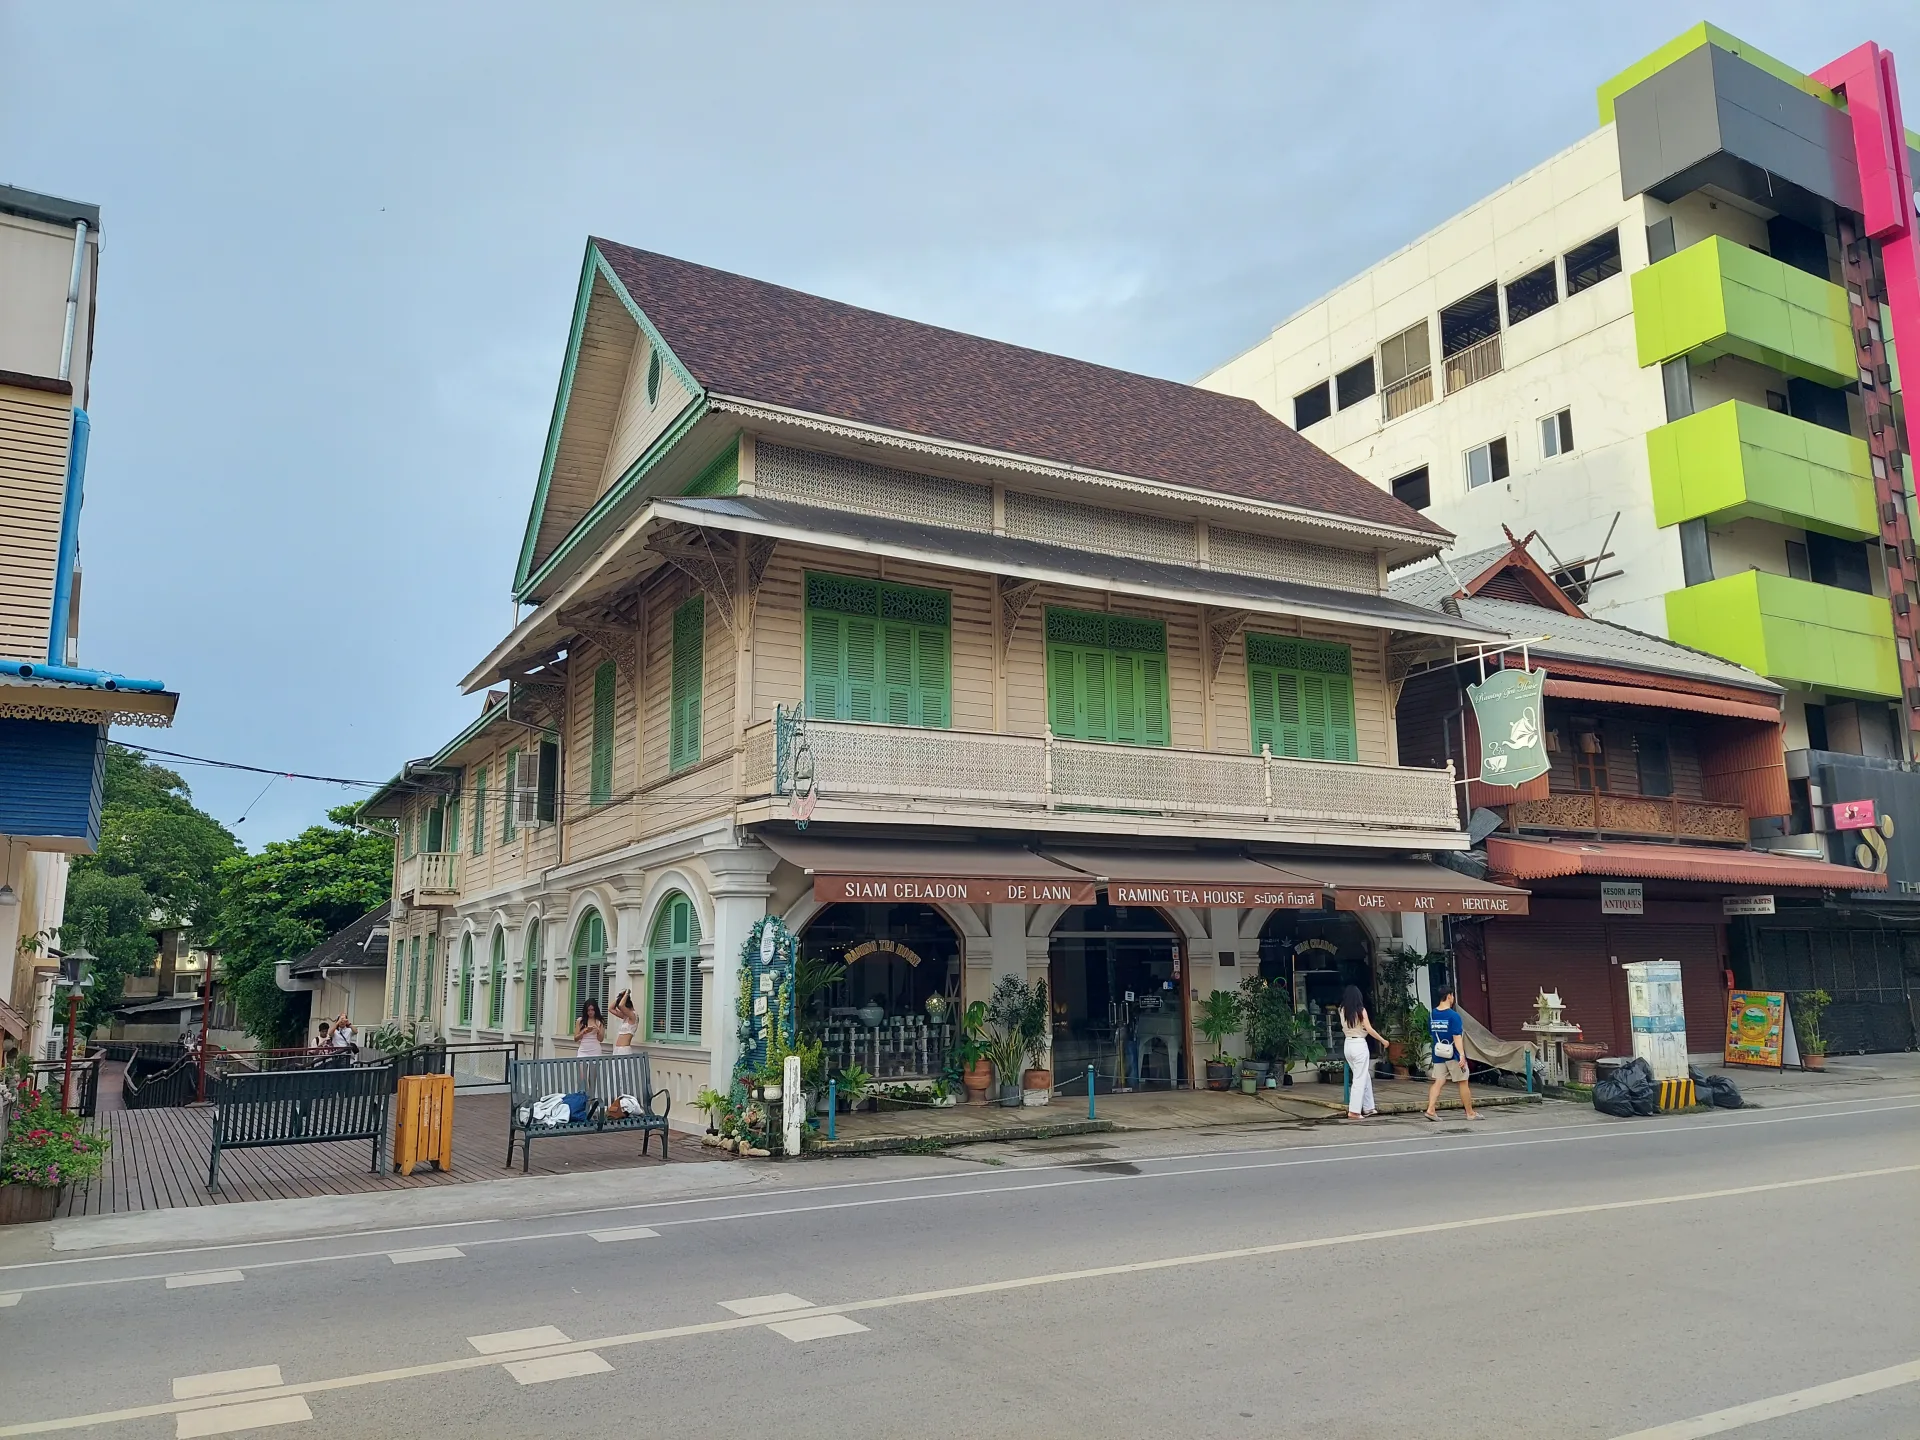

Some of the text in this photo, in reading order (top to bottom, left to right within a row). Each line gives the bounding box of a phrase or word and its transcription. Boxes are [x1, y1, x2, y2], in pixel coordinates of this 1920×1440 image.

[845, 883, 1071, 900] SIAM CELADON DE LANN
[1118, 888, 1245, 904] RAMING TEA HOUSE
[1603, 888, 1626, 896] KESORN
[1358, 895, 1509, 911] CAFE ART HERITAGE
[1604, 900, 1642, 910] ANTIQUES
[879, 940, 895, 953] TEA
